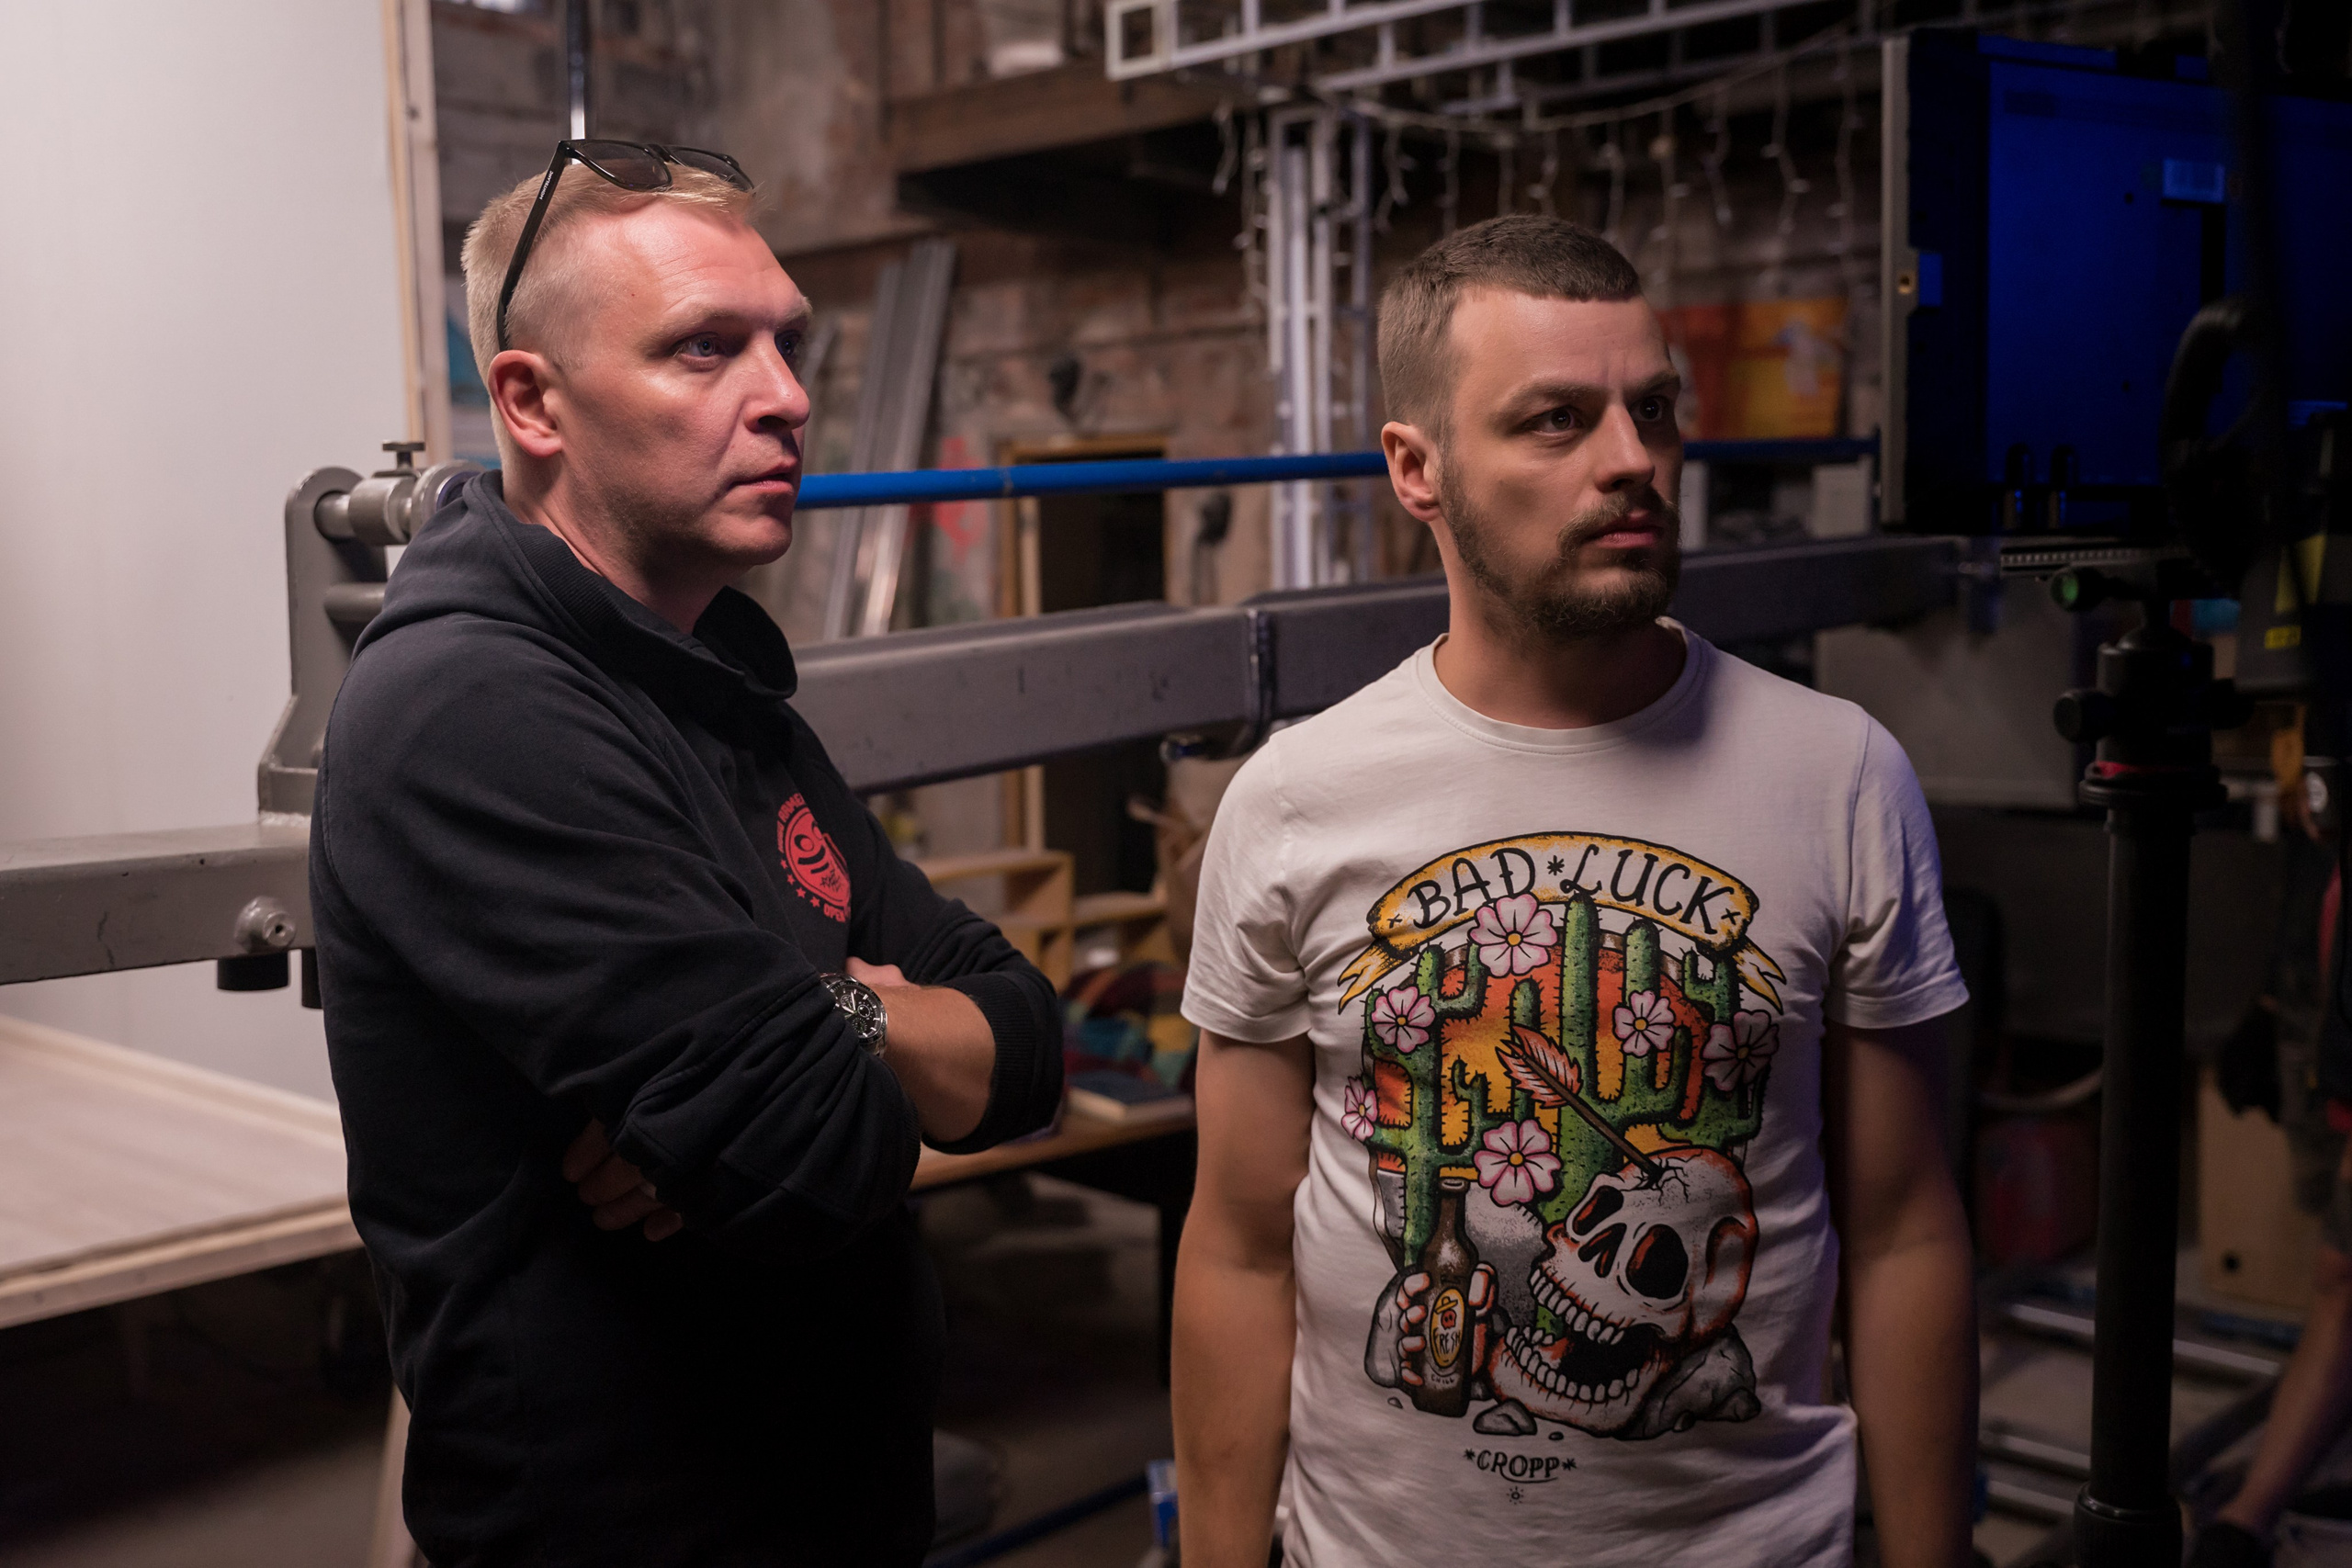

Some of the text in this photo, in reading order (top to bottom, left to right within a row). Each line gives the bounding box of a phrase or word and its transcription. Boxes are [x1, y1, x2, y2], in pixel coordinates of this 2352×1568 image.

[1407, 843, 1735, 935] BAD LUCK
[1432, 1327, 1461, 1358] FRESH
[1476, 1450, 1560, 1483] CROPP
